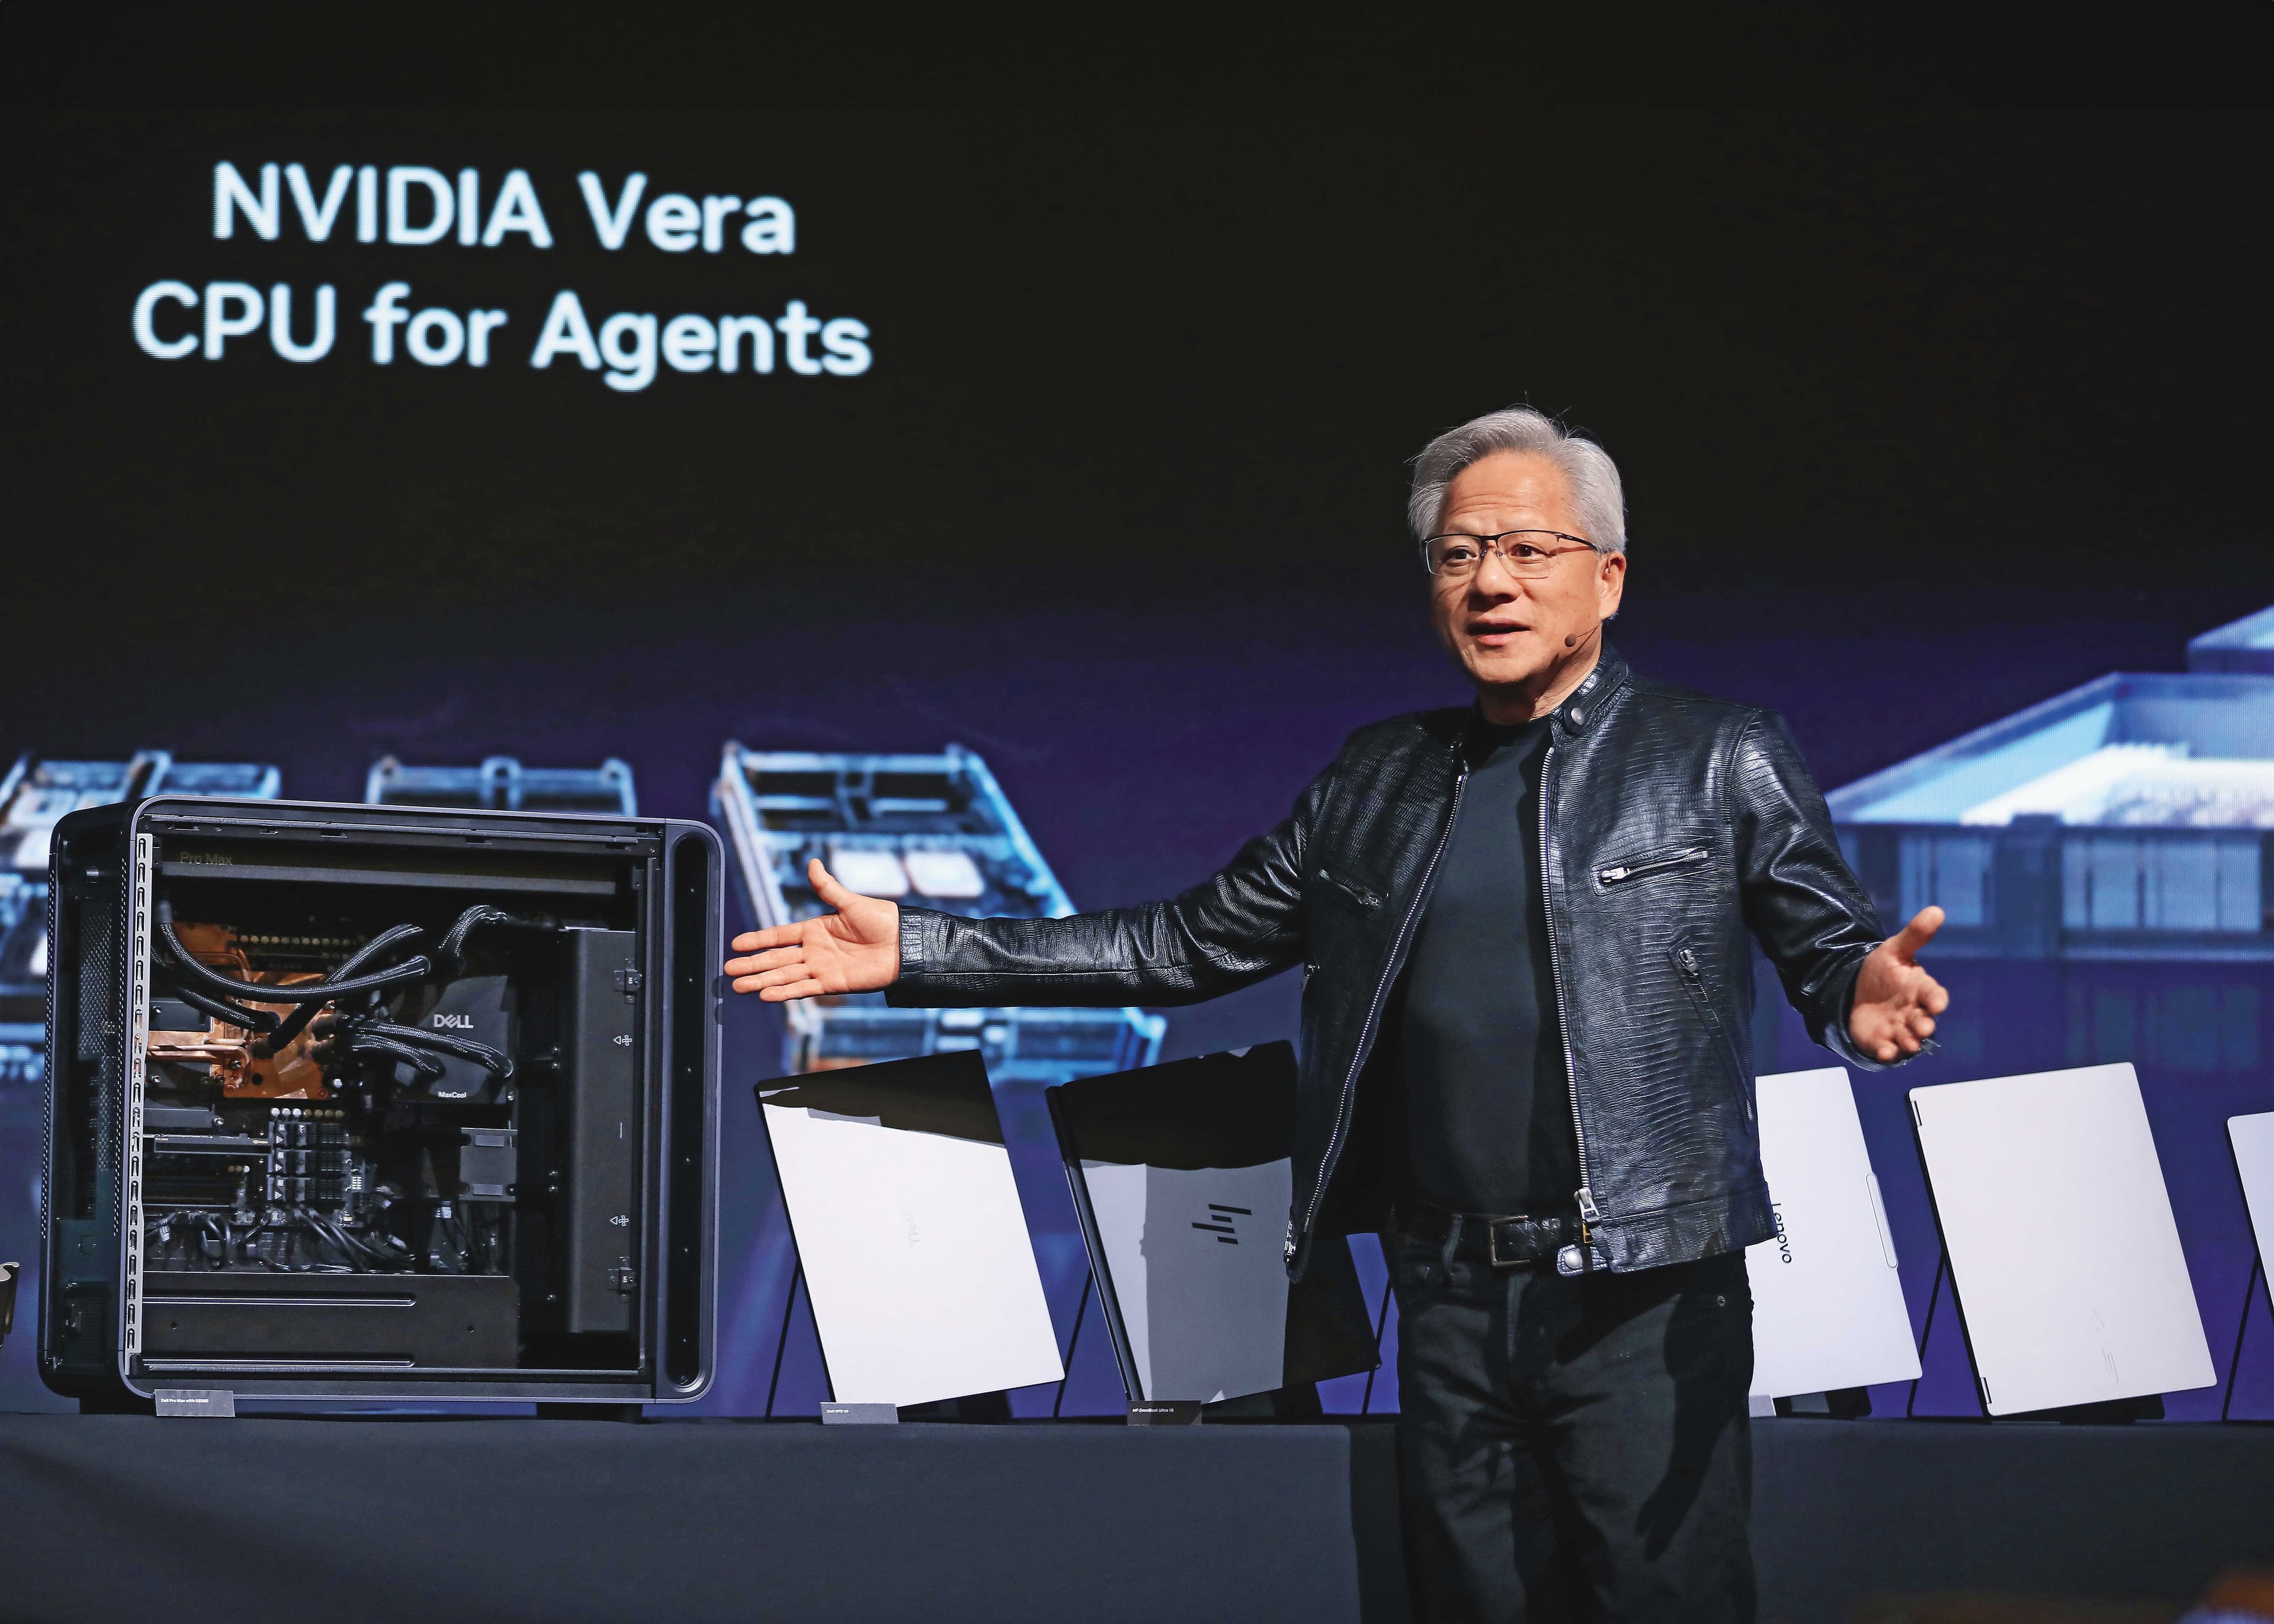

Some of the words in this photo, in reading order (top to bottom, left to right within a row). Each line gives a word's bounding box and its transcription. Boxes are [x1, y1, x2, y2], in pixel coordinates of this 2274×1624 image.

[213, 161, 555, 249] NVIDIA
[577, 171, 795, 255] Vera
[131, 279, 336, 364] CPU
[362, 282, 508, 368] for
[530, 290, 872, 393] Agents
[180, 852, 201, 864] Pro
[206, 853, 233, 866] Max
[433, 1014, 474, 1029] DELL
[438, 1091, 467, 1099] MaxCool
